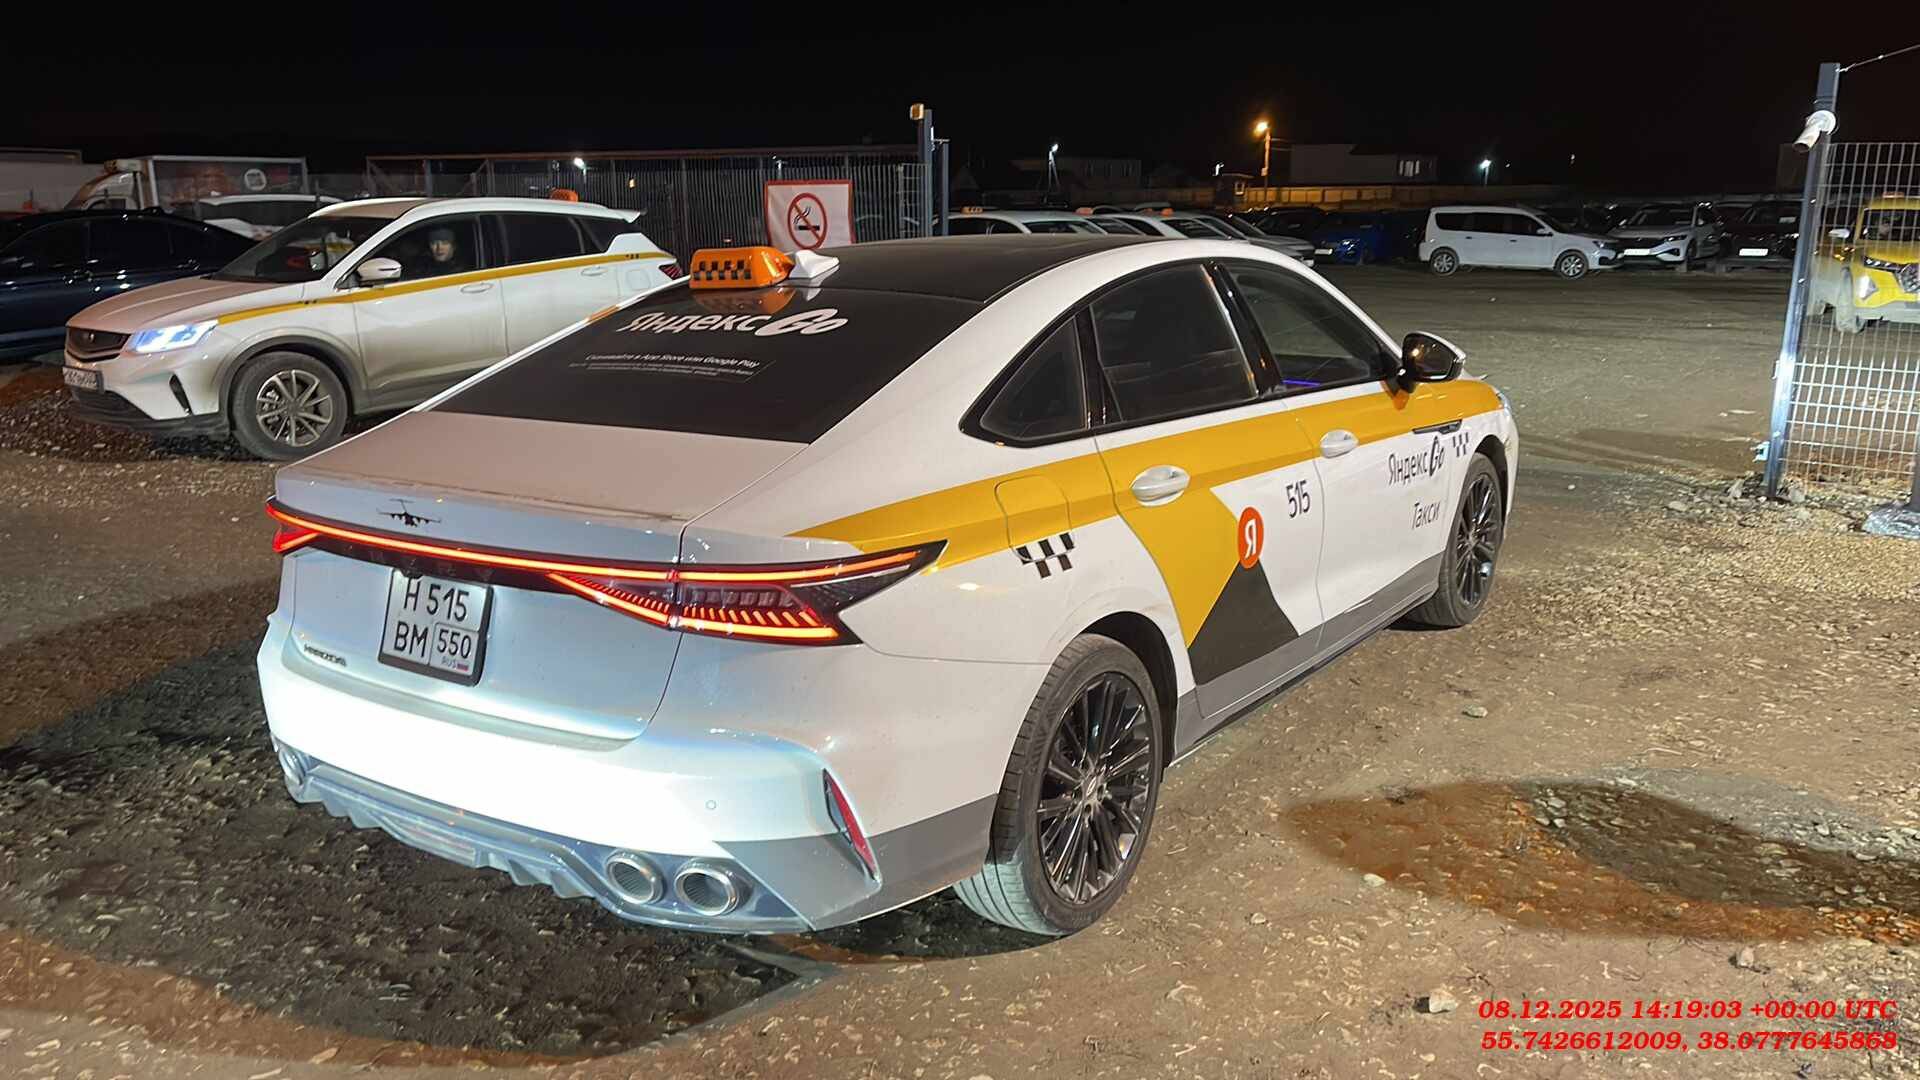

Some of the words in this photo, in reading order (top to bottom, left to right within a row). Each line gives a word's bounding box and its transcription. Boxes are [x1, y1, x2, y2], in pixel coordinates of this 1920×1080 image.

[616, 312, 771, 333] Яндекс
[755, 309, 848, 336] Go
[1388, 450, 1428, 486] Яндекс
[1429, 436, 1445, 477] Go
[1285, 480, 1311, 518] 515
[1412, 501, 1441, 530] Такси
[1245, 519, 1257, 560] Я
[404, 577, 421, 611] Н
[426, 583, 470, 622] 515
[394, 620, 429, 658] ВМ
[437, 628, 472, 659] 550
